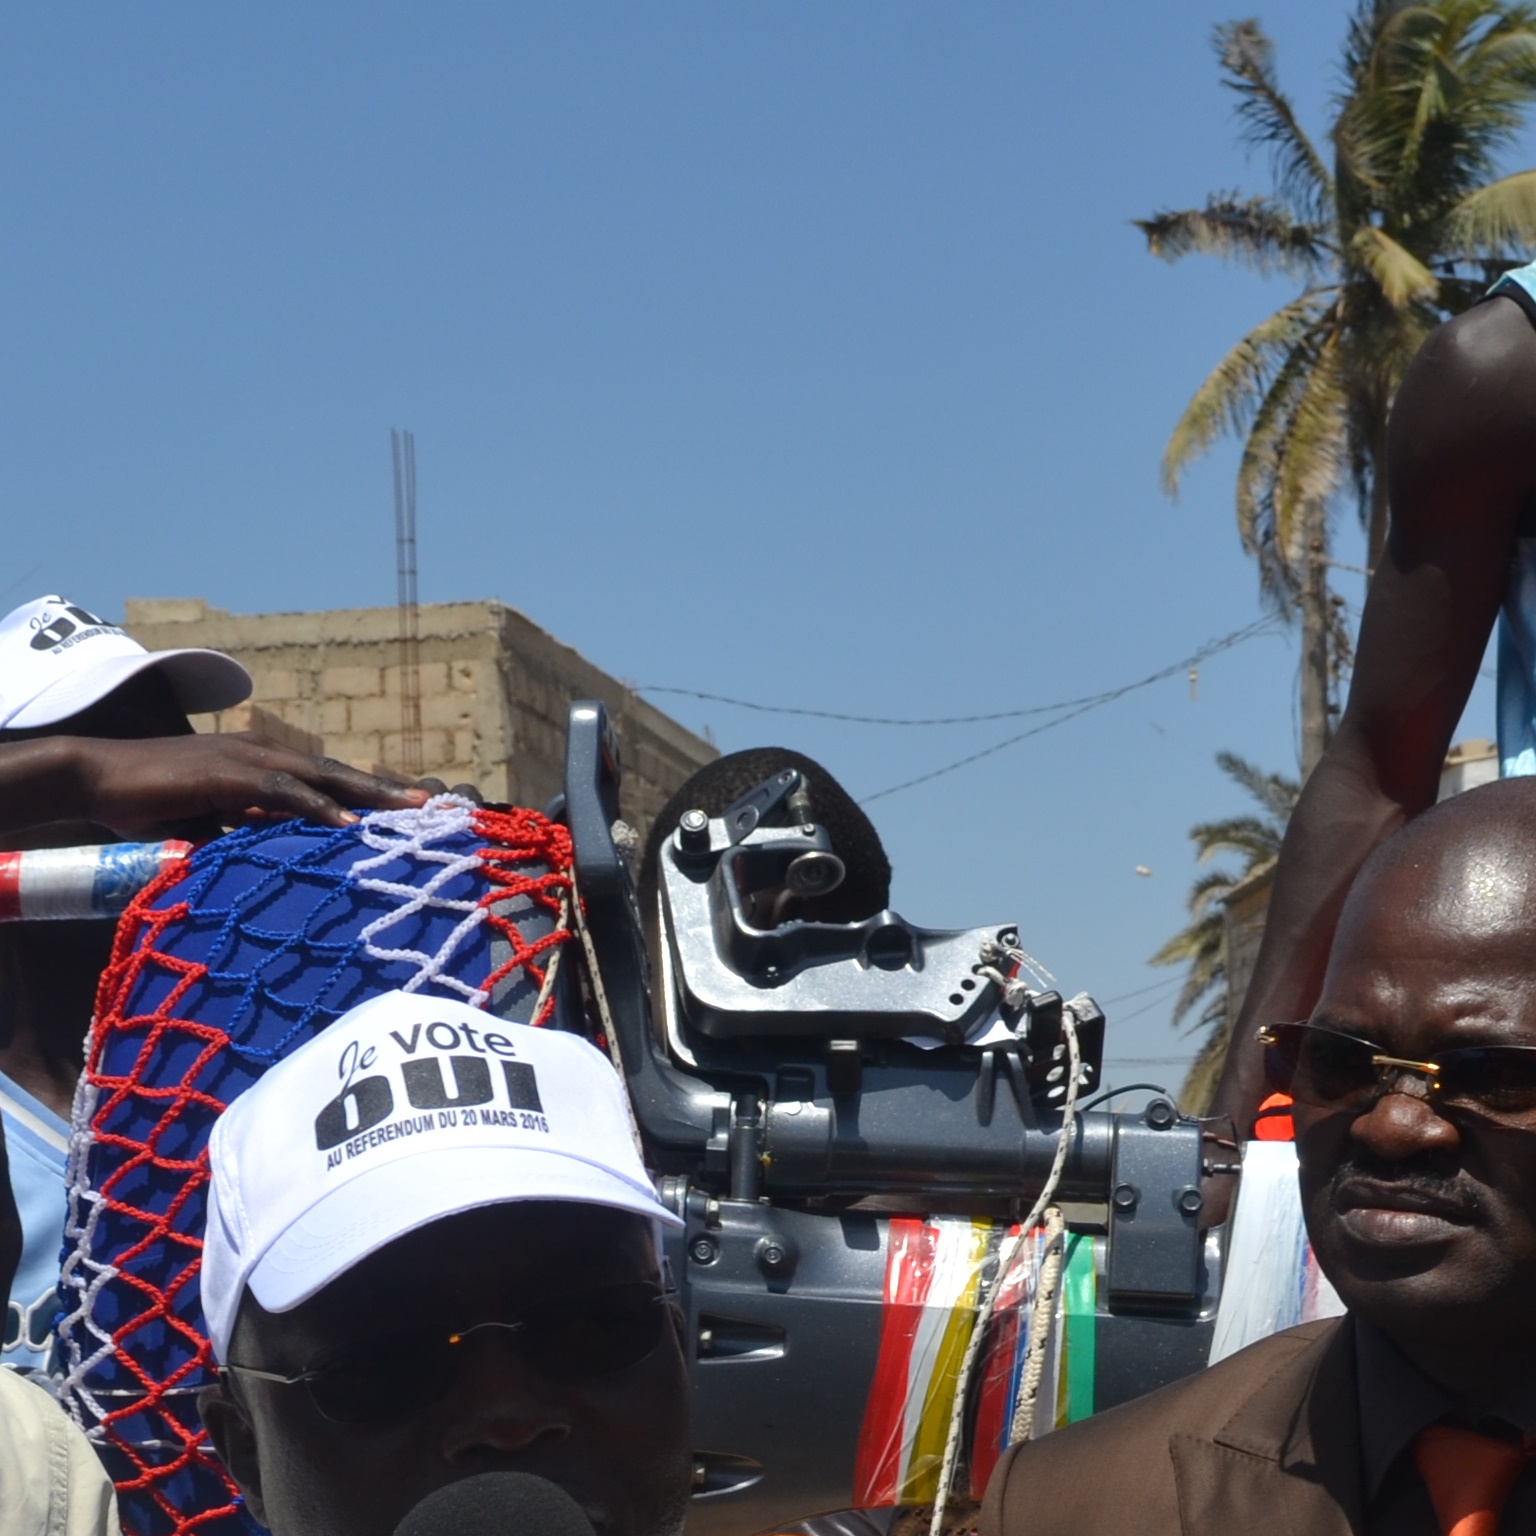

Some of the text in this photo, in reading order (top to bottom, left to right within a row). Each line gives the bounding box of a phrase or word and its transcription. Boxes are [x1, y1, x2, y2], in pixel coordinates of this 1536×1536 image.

[30, 606, 115, 651] OU
[339, 1040, 377, 1097] Je
[314, 1055, 544, 1151] OUI
[326, 1109, 549, 1171] AU REFERENDUM DU 20 MARS 2016
